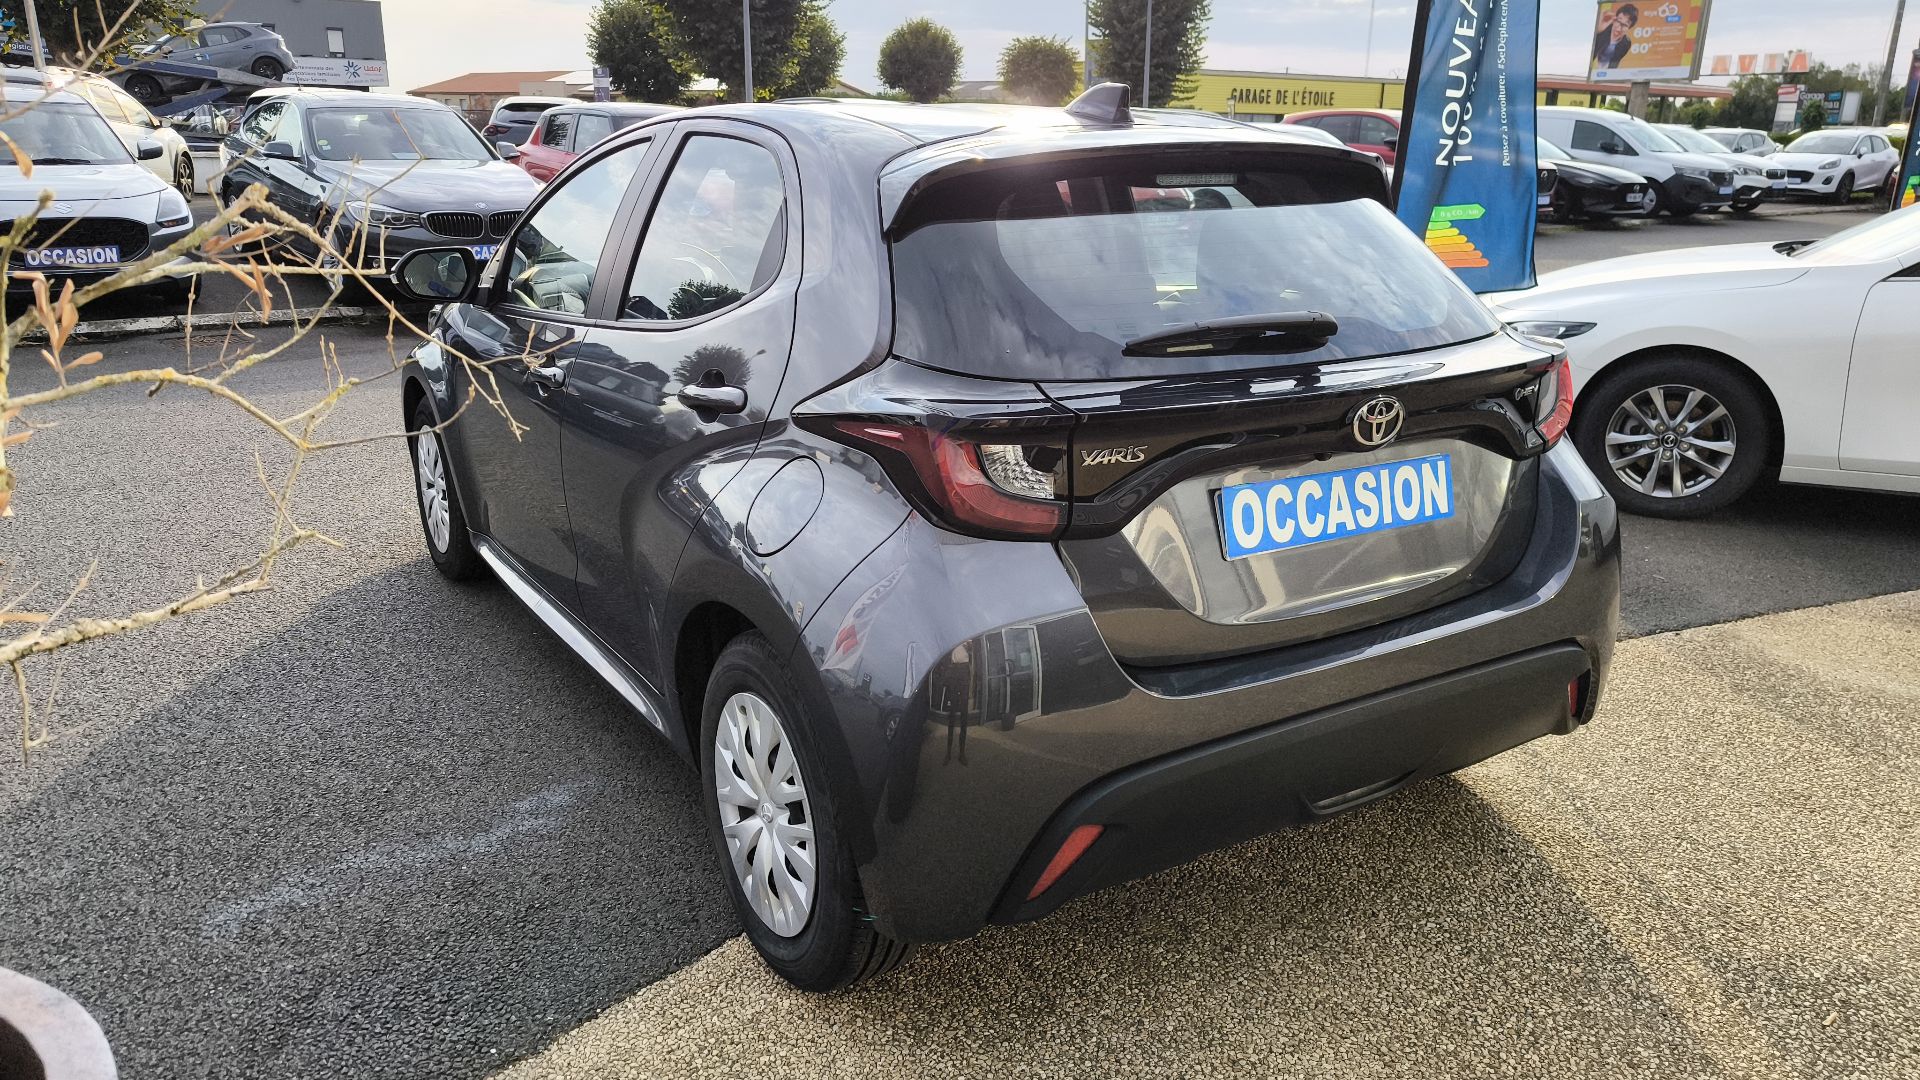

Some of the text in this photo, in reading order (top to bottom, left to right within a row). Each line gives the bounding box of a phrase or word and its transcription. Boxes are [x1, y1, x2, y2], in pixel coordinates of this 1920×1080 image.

[1712, 51, 1809, 74] AVIA
[1231, 86, 1335, 106] GARAGE DE L'ÉTOILE
[26, 247, 118, 266] OCCASION
[1231, 459, 1451, 550] OCCASION
